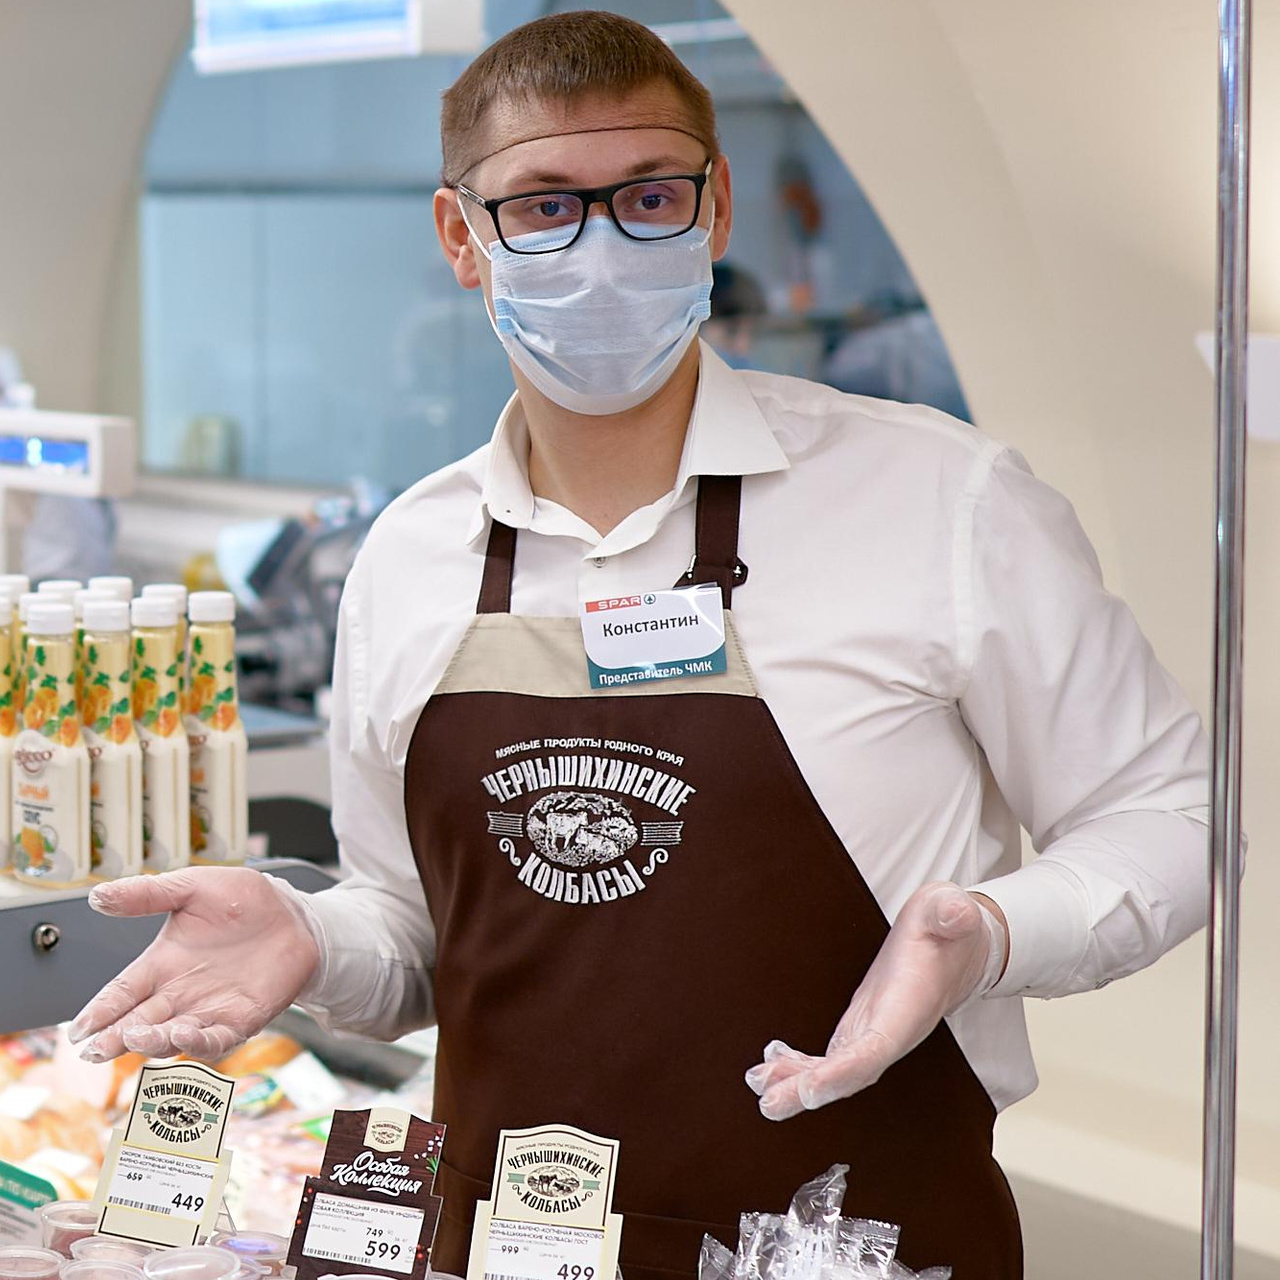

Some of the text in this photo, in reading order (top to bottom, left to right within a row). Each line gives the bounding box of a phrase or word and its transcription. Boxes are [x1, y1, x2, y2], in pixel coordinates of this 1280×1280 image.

[598, 596, 641, 610] SPAR
[603, 615, 699, 637] Константин
[599, 661, 713, 686] Представитель ЧМК
[495, 738, 684, 766] МЯСНЫЕ ПРОДУКТЫ РОДНОГО КРАЯ
[481, 755, 697, 816] ЧЕРНЫШИХИНСКИЕ
[518, 853, 646, 904] КОЛБАСЫ
[143, 1083, 224, 1112] ЧЕРНЫШИХИНСКИЕ
[150, 1121, 200, 1143] КОЛБАСЫ
[353, 1151, 410, 1176] Особая
[507, 1150, 605, 1178] ЧЕРНЫШИХИНСКИЕ
[330, 1164, 422, 1196] Коллекция
[171, 1193, 204, 1212] 449
[521, 1191, 581, 1213] КОЛБАСЫ
[366, 1227, 384, 1237] 749
[365, 1240, 401, 1260] 599
[501, 1245, 519, 1254] 999
